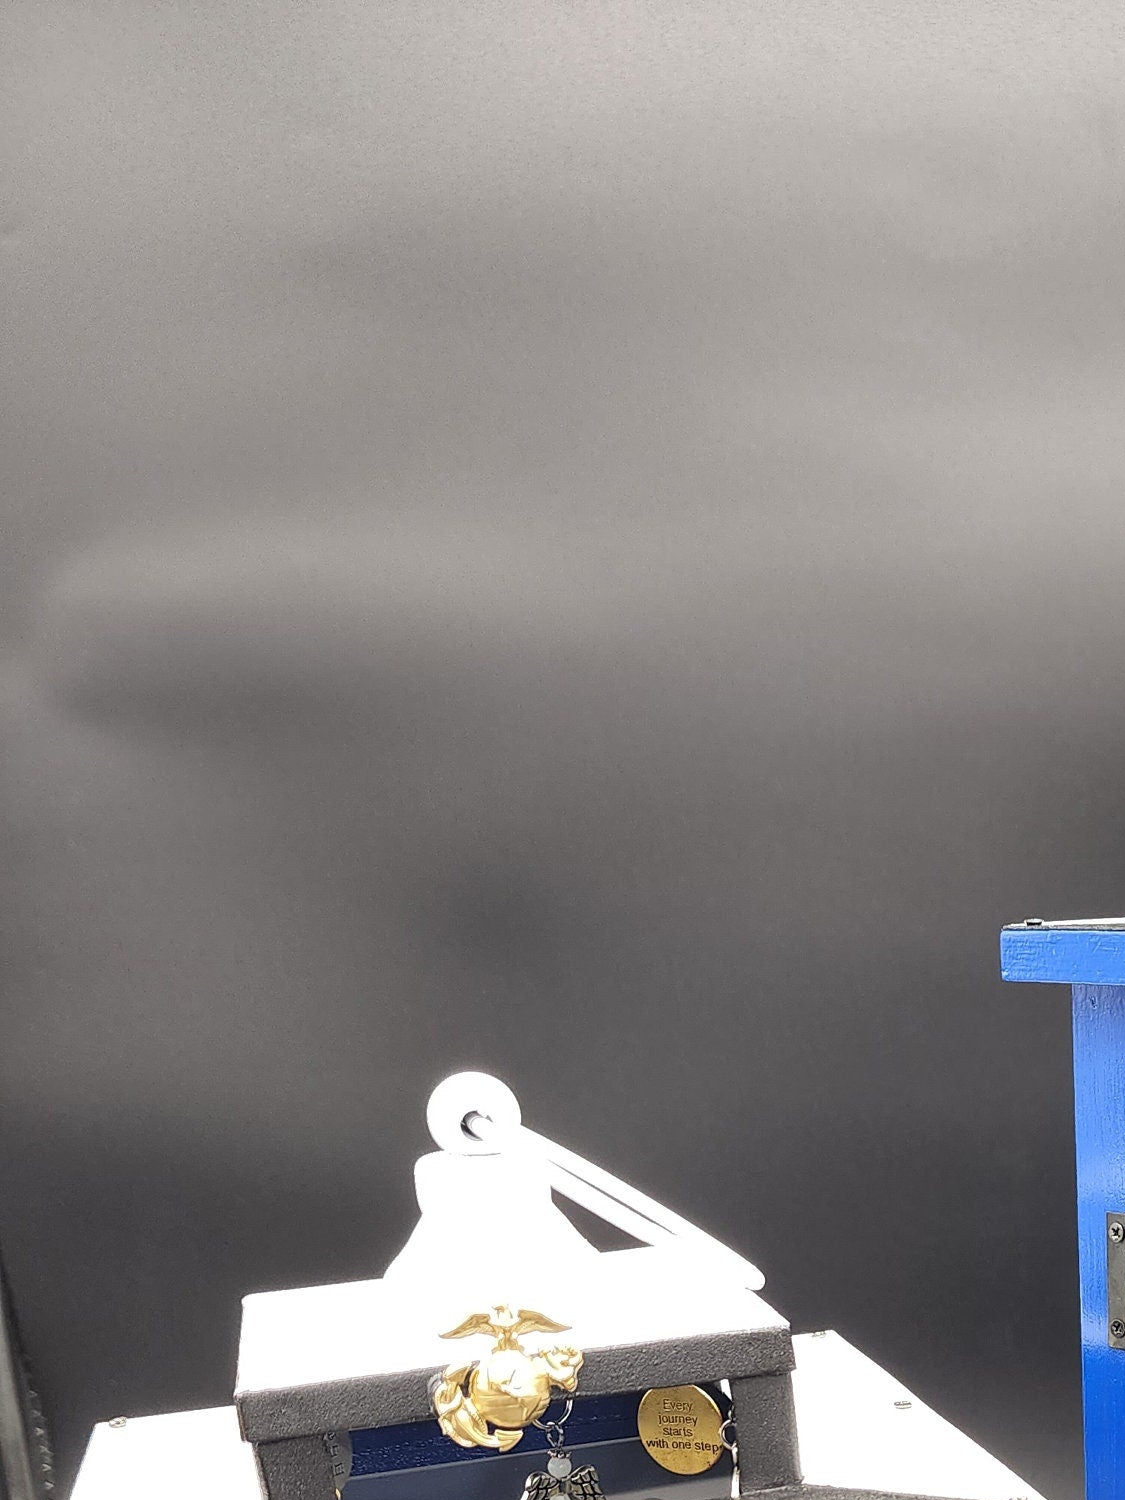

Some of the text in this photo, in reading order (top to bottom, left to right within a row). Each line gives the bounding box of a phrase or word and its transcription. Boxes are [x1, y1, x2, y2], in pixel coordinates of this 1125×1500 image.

[663, 1399, 693, 1412] Every
[658, 1412, 697, 1427] journey
[646, 1438, 669, 1450] with
[672, 1441, 691, 1450] one
